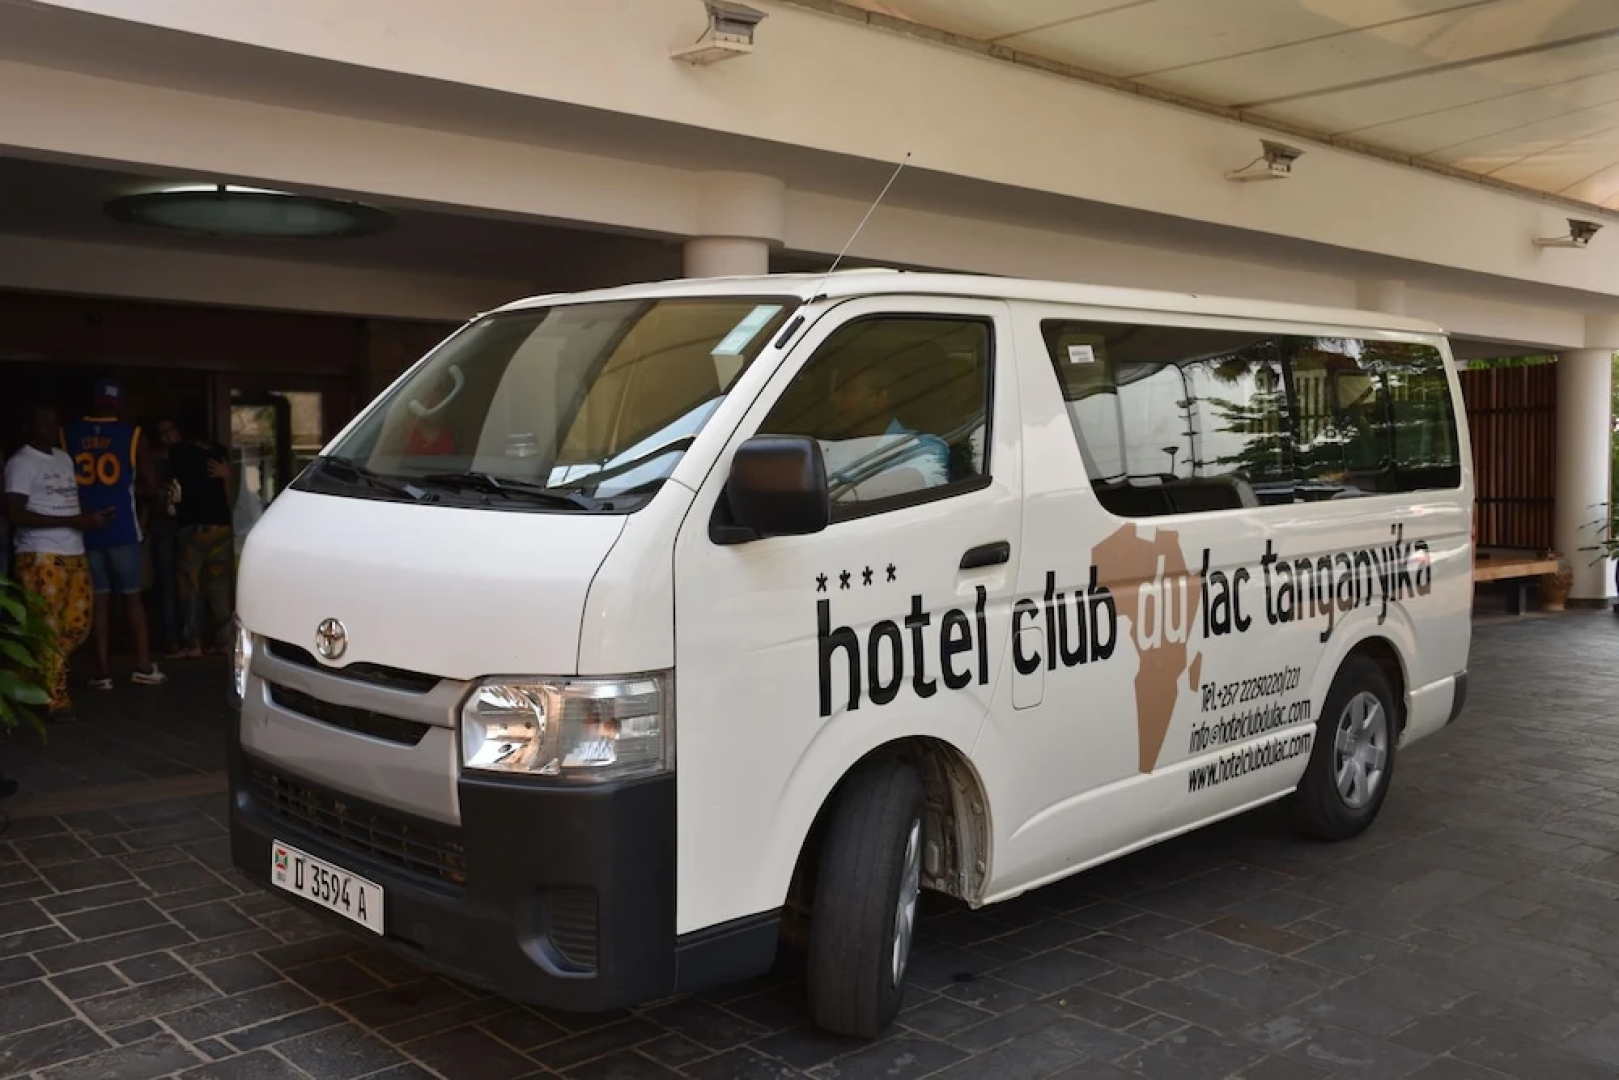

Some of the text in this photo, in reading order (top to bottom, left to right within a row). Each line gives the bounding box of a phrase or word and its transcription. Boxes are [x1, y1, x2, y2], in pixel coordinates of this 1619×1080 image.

[75, 452, 121, 487] 30
[816, 523, 1431, 718] hotel club du lac tanganyika
[1189, 699, 1311, 754] info@hotelclubdulac.com
[1188, 732, 1311, 793] www.hotelclubdulac.com
[295, 857, 367, 921] D 3594 A
